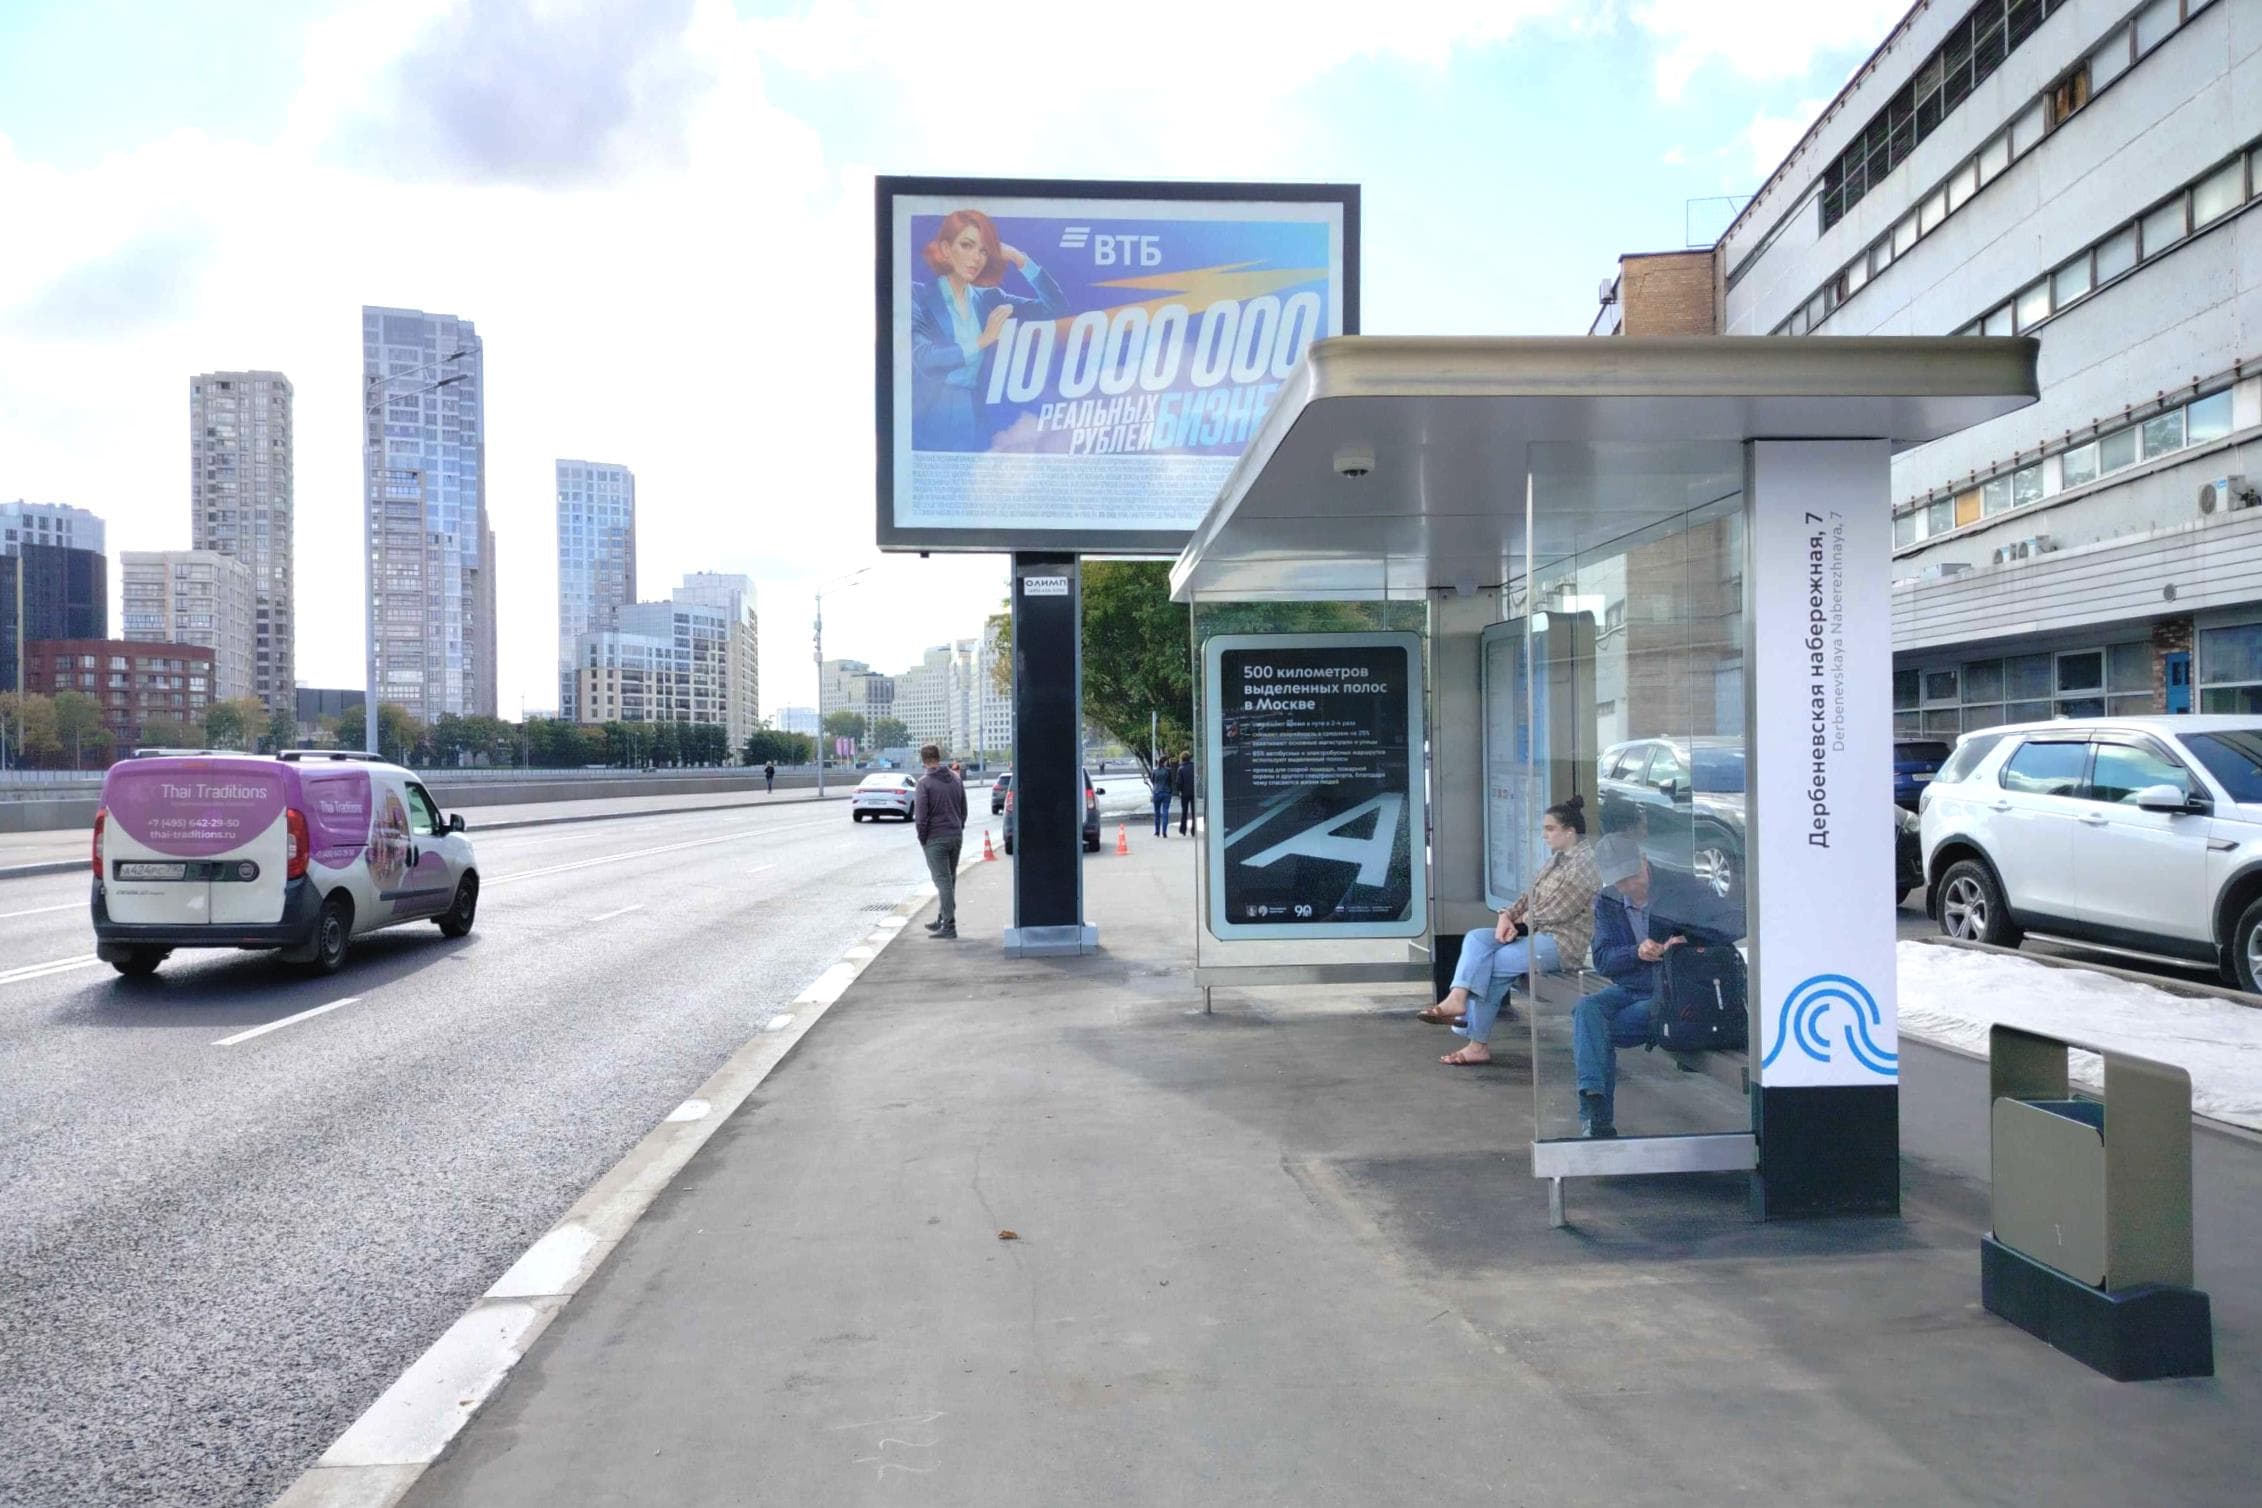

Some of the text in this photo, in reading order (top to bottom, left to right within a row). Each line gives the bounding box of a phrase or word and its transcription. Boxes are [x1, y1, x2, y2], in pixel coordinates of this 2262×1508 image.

[1095, 234, 1162, 266] ВТБ
[985, 291, 1321, 404] 10 000 000
[1037, 394, 1160, 433] РЕАЛЬНЫХ
[1151, 383, 1282, 449] БИЗНЕ
[1068, 418, 1154, 456] РУБЛЕЙ
[1830, 511, 1845, 752] Derbenevskaya Naberezhnaya, 7
[1243, 666, 1369, 680] 500 километров
[1805, 512, 1830, 848] Дербеневская набережная, 7
[1244, 683, 1388, 696] выделенных полос
[1244, 698, 1316, 711] в Москве
[160, 784, 267, 799] Thai Traditions
[150, 829, 237, 839] thai-traditions.ru
[162, 818, 186, 829] (495)
